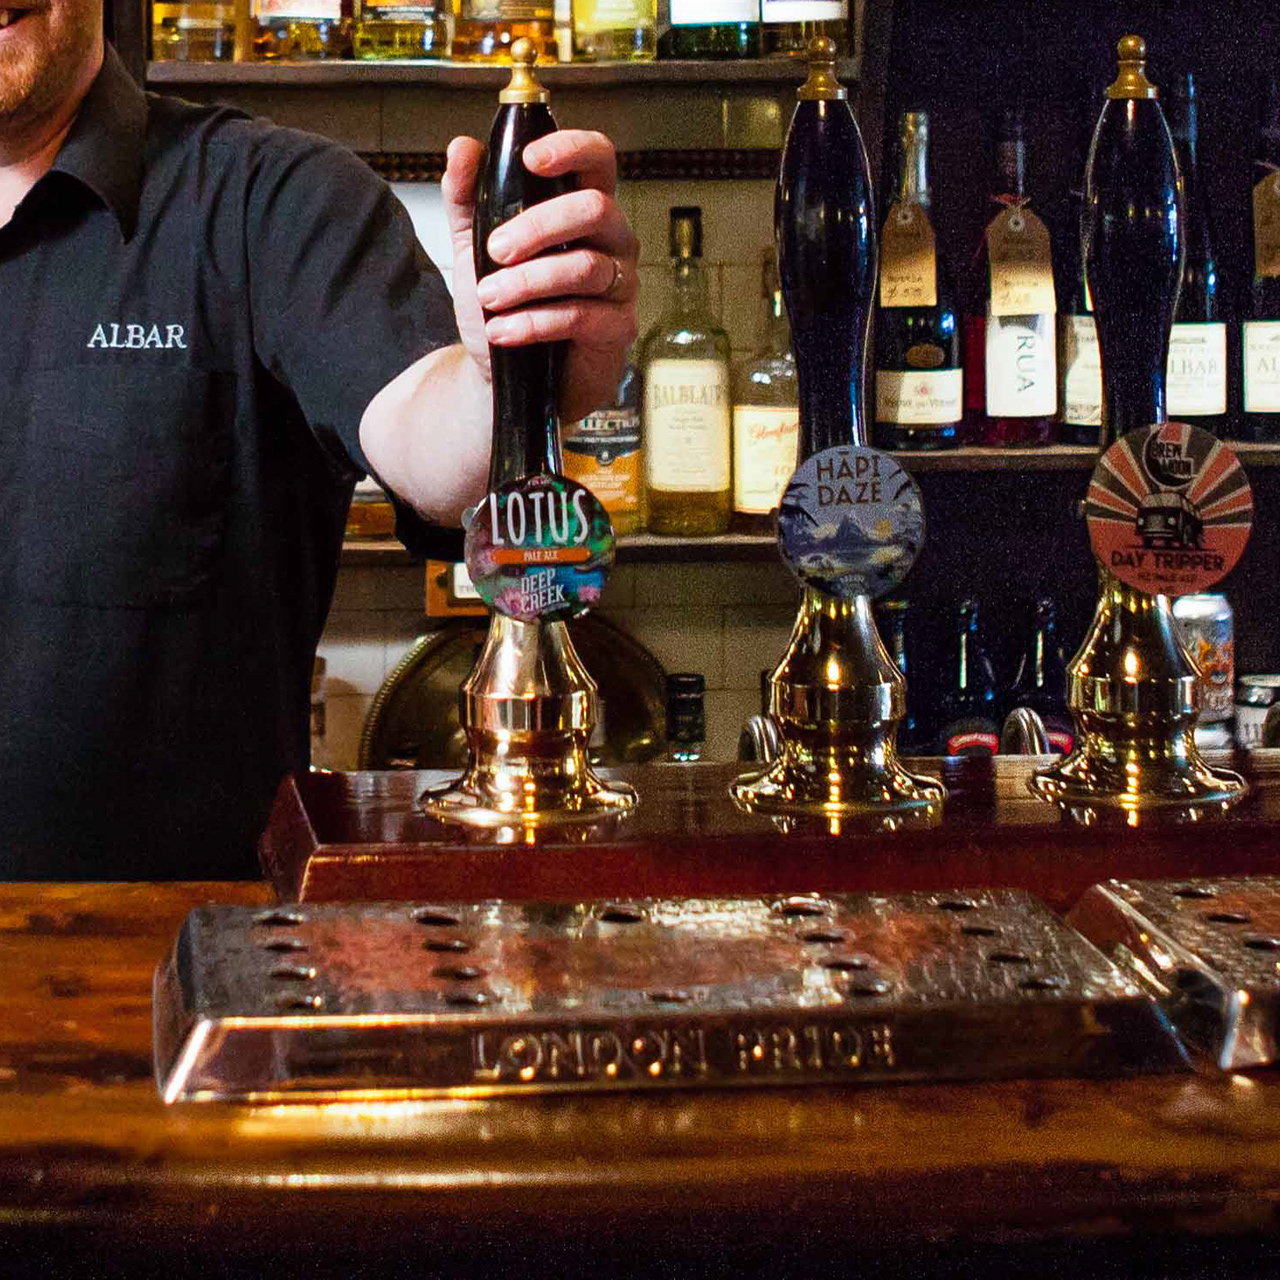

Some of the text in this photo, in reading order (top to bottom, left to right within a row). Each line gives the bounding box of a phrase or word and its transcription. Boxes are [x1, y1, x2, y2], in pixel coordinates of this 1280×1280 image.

[87, 323, 188, 348] ALBAR
[1017, 335, 1036, 392] RUA
[1171, 358, 1218, 375] LBAR
[817, 482, 882, 508] DAZE
[490, 489, 589, 545] LOTUS
[523, 550, 559, 561] PALE ALE
[1111, 550, 1225, 571] DAY TRIPPER
[521, 568, 556, 595] DEEP
[521, 584, 565, 614] CREEK
[473, 1031, 708, 1079] LONDON
